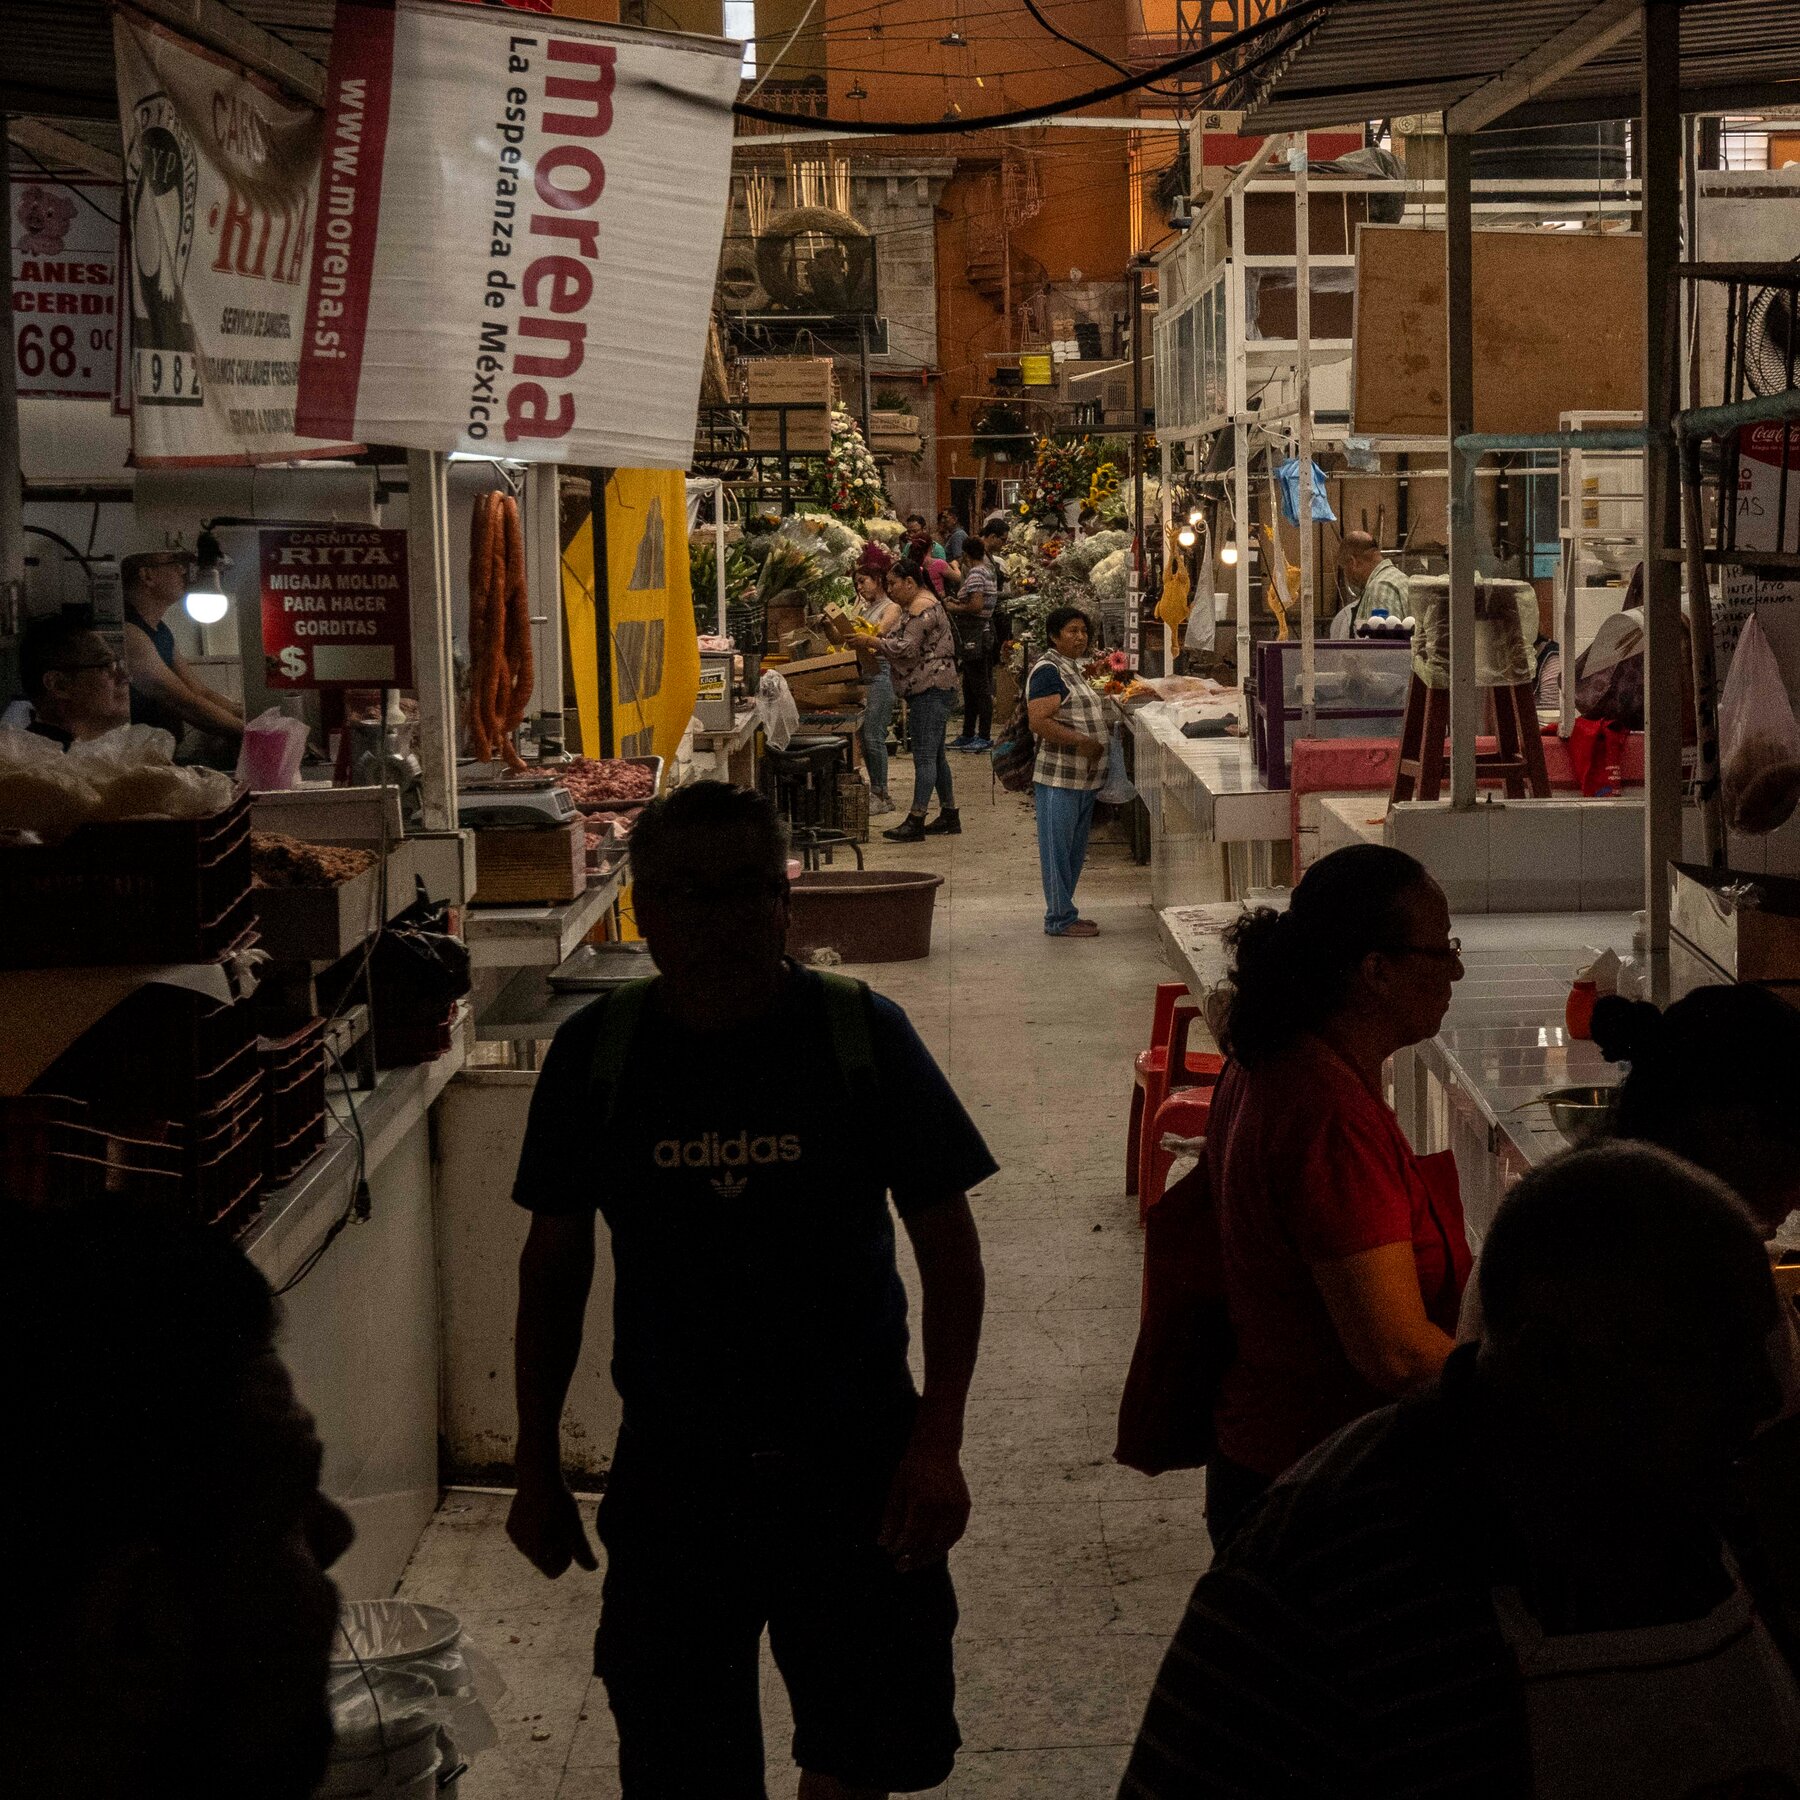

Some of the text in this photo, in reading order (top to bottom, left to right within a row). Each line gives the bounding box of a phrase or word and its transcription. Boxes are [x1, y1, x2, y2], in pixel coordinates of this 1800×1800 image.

[313, 78, 367, 360] www.morena.si
[467, 36, 538, 440] La esperanza de México
[504, 39, 617, 442] morena
[279, 548, 395, 565] RITA
[270, 574, 400, 590] MIGAJA MOLIDA
[284, 596, 388, 612] PARA HACER
[294, 620, 378, 636] GORDITAS
[652, 1128, 802, 1168] adidas
